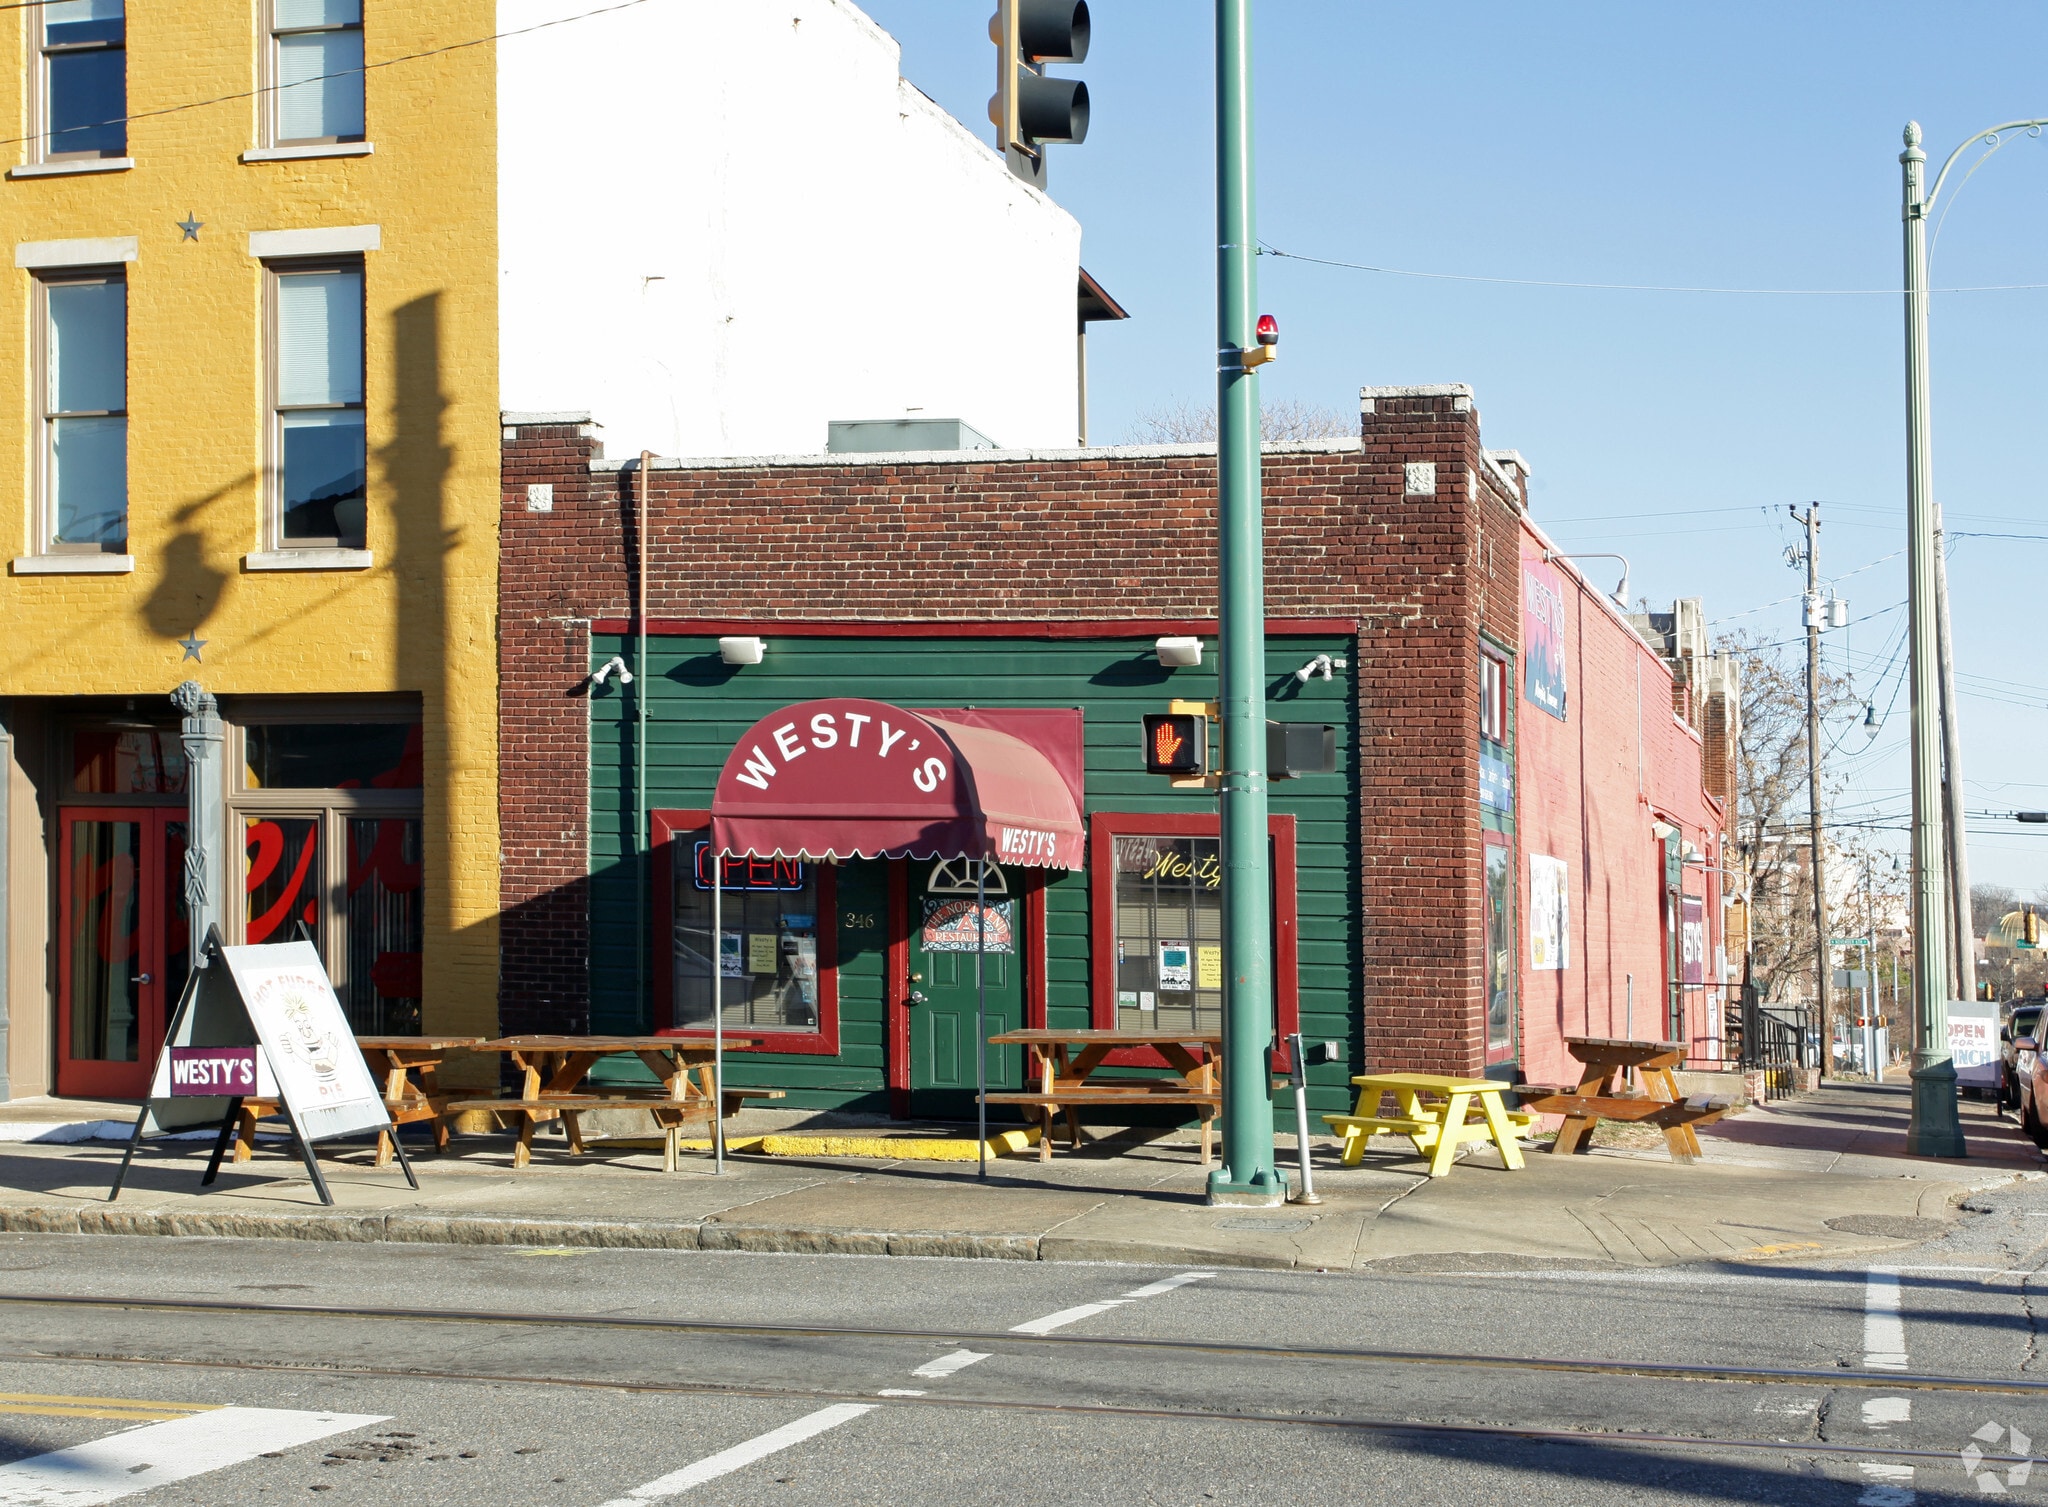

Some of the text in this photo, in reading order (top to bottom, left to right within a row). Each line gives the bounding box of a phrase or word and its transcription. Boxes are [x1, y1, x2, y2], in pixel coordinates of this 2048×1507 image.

[736, 713, 947, 793] WESTY'S
[1002, 827, 1056, 857] WESTY'S
[845, 912, 875, 928] 346
[926, 901, 1008, 934] THE NORT END
[935, 932, 1000, 942] RESTAURNT
[1683, 921, 1703, 964] ESTY'S
[253, 979, 272, 1006] HOT
[1951, 1039, 1974, 1047] FOR
[173, 1058, 253, 1085] WESTY'S
[1952, 1049, 1991, 1067] UNCH
